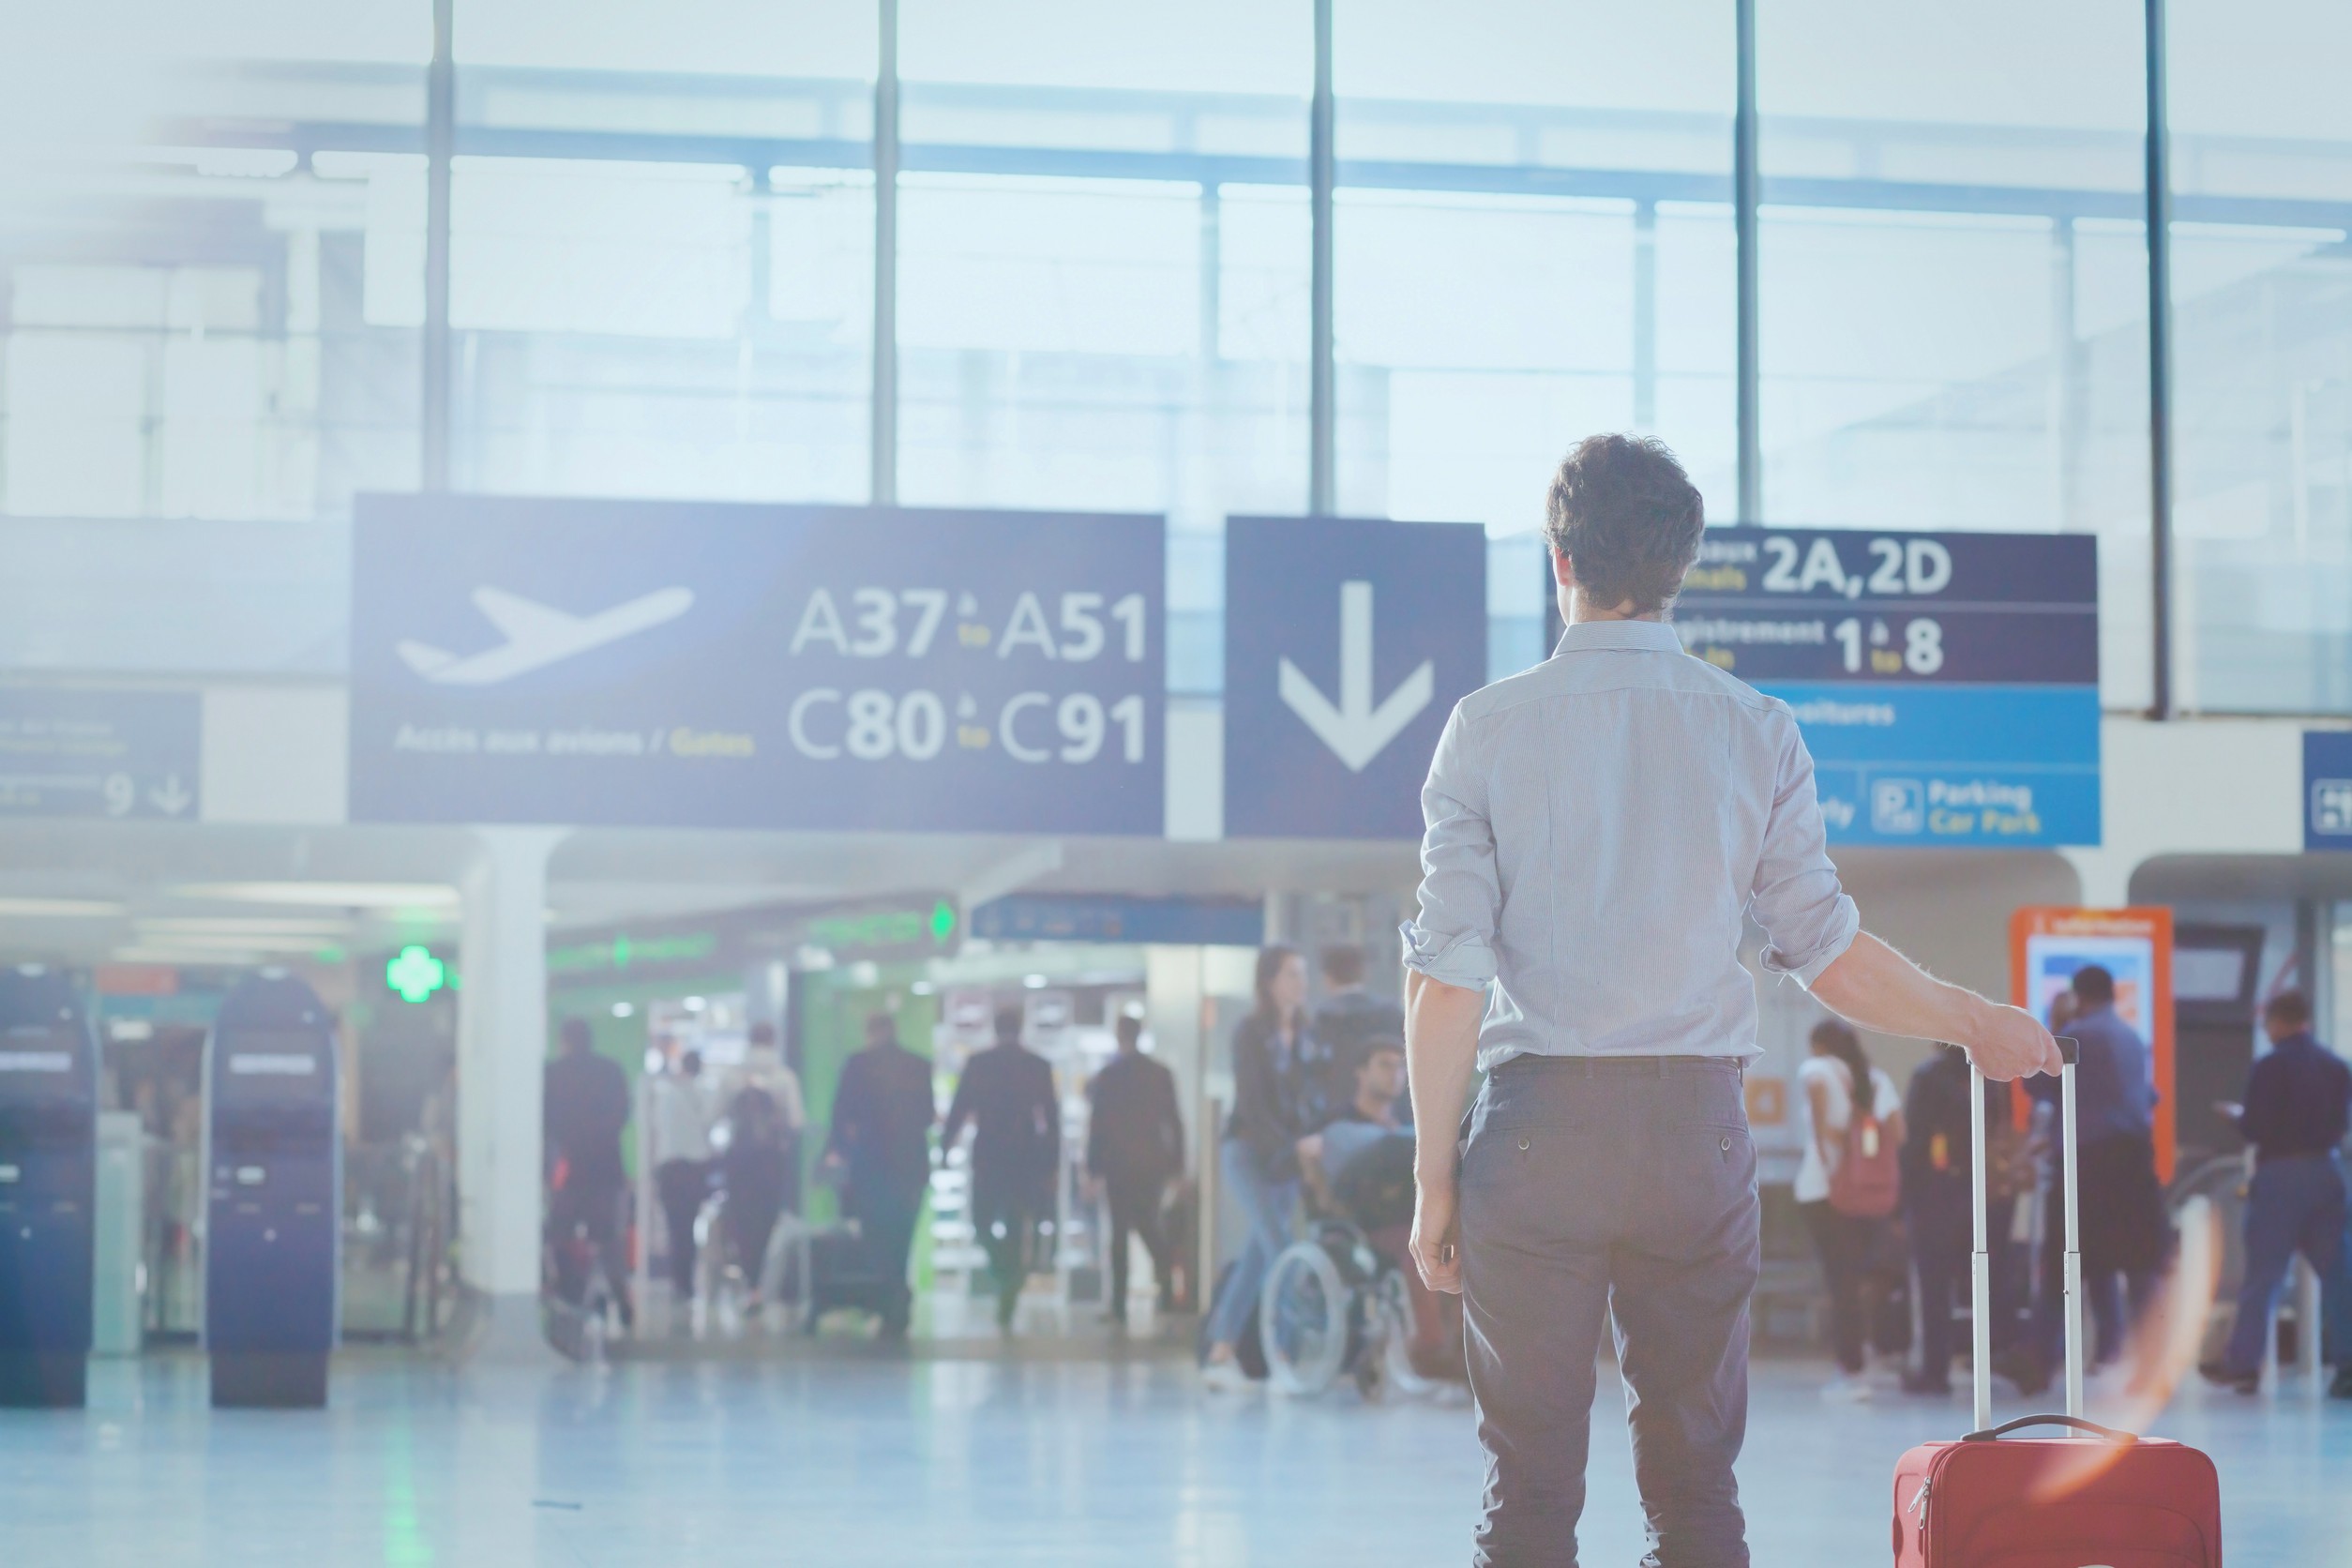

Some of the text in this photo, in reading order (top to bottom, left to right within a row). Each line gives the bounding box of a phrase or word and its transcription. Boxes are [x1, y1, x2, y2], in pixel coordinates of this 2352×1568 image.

[789, 587, 948, 658] A37
[996, 592, 1145, 662] A51
[956, 623, 991, 648] to
[1833, 617, 1862, 672] 1
[1869, 617, 1890, 645] à
[1905, 617, 1944, 675] 8
[1870, 648, 1903, 673] to
[483, 727, 539, 754] aux
[545, 723, 644, 755] avions
[668, 725, 757, 758] Gates
[788, 687, 947, 761] C80
[999, 692, 1144, 763] C91
[956, 723, 991, 750] to
[104, 771, 135, 817] 9
[1928, 779, 2032, 812] Parking
[1929, 807, 1974, 835] Car
[1982, 807, 2042, 835] Park
